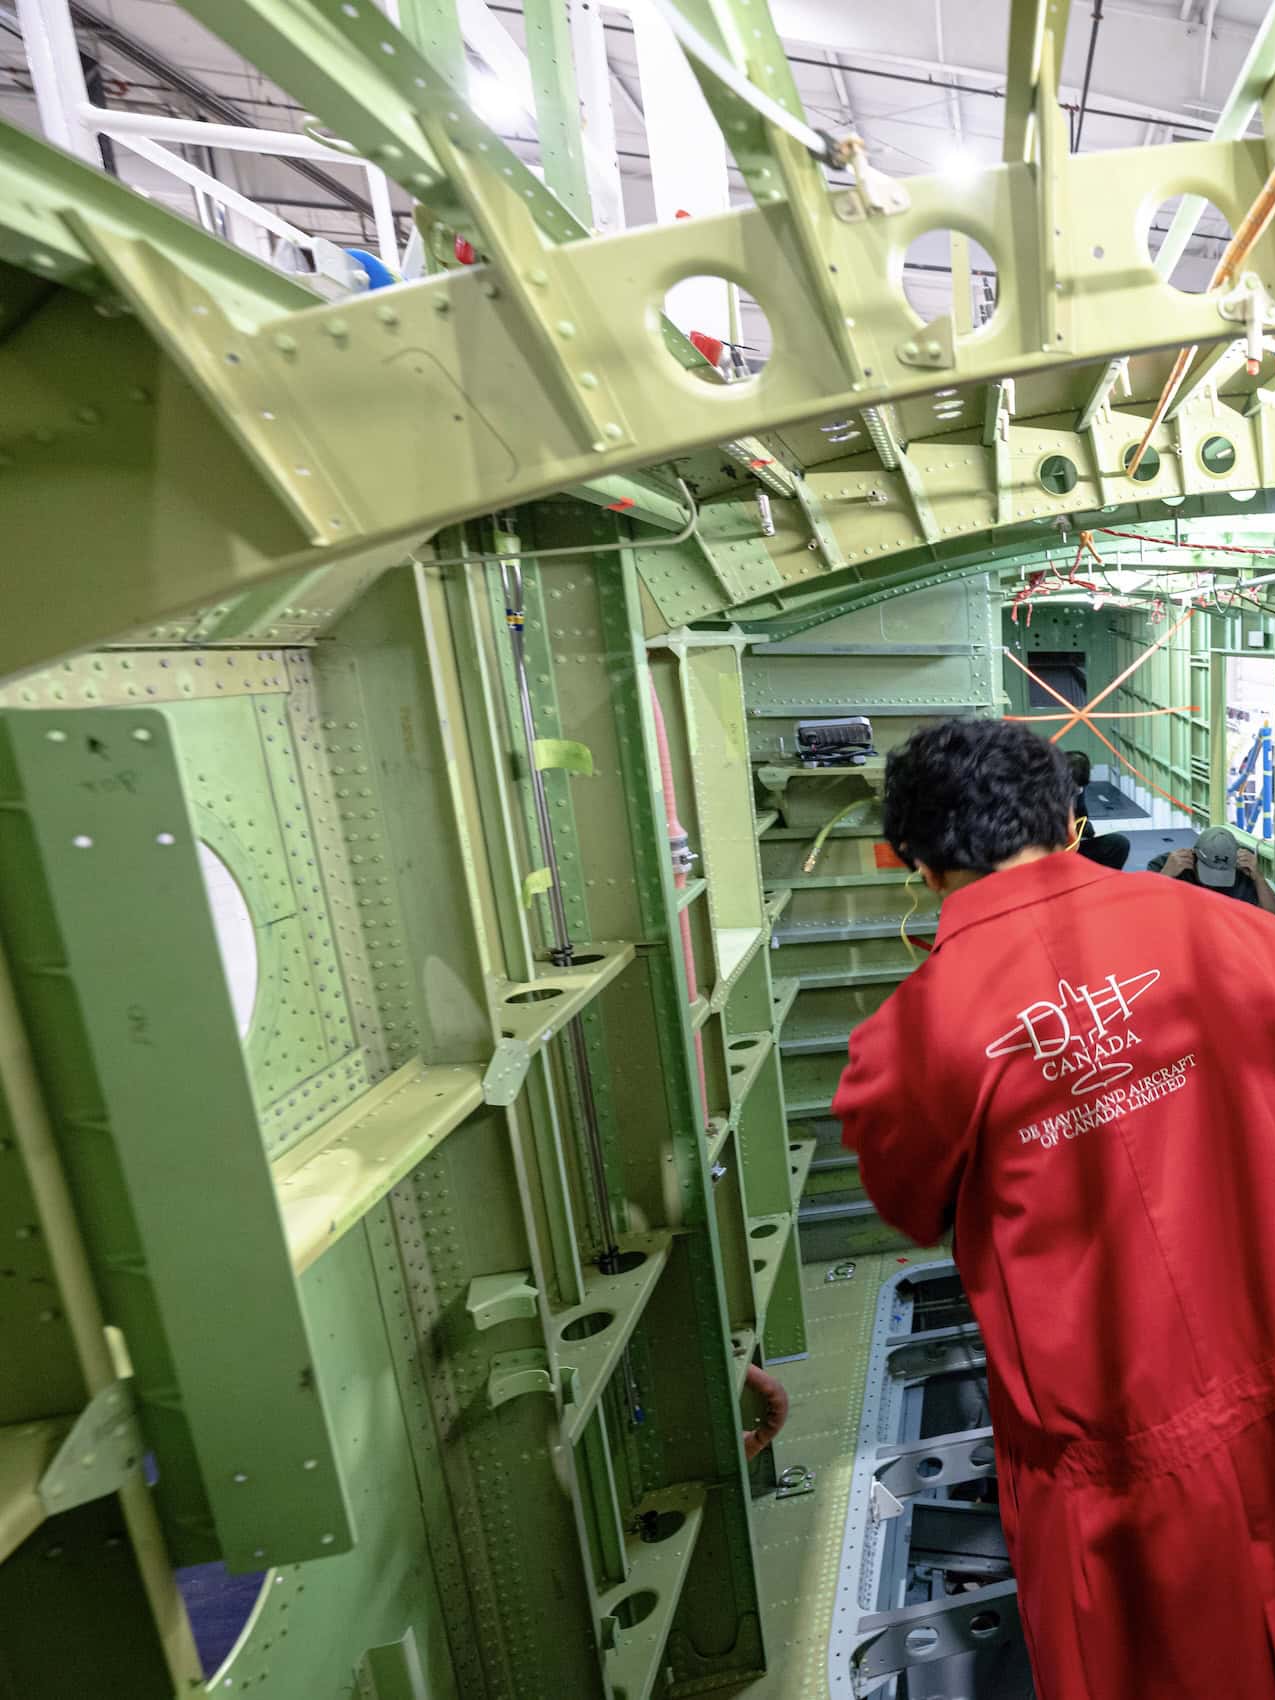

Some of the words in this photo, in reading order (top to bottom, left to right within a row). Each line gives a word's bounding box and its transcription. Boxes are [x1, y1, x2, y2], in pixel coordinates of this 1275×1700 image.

[1016, 974, 1133, 1060] DH
[1042, 1028, 1143, 1081] CANADA
[1018, 1123, 1041, 1144] DE
[1041, 1088, 1126, 1135] HAVILLAND
[1129, 1053, 1196, 1097] AIRCRAFT
[1039, 1130, 1059, 1149] OF
[1062, 1103, 1127, 1140] CANADA
[1127, 1074, 1187, 1111] LIMITED
